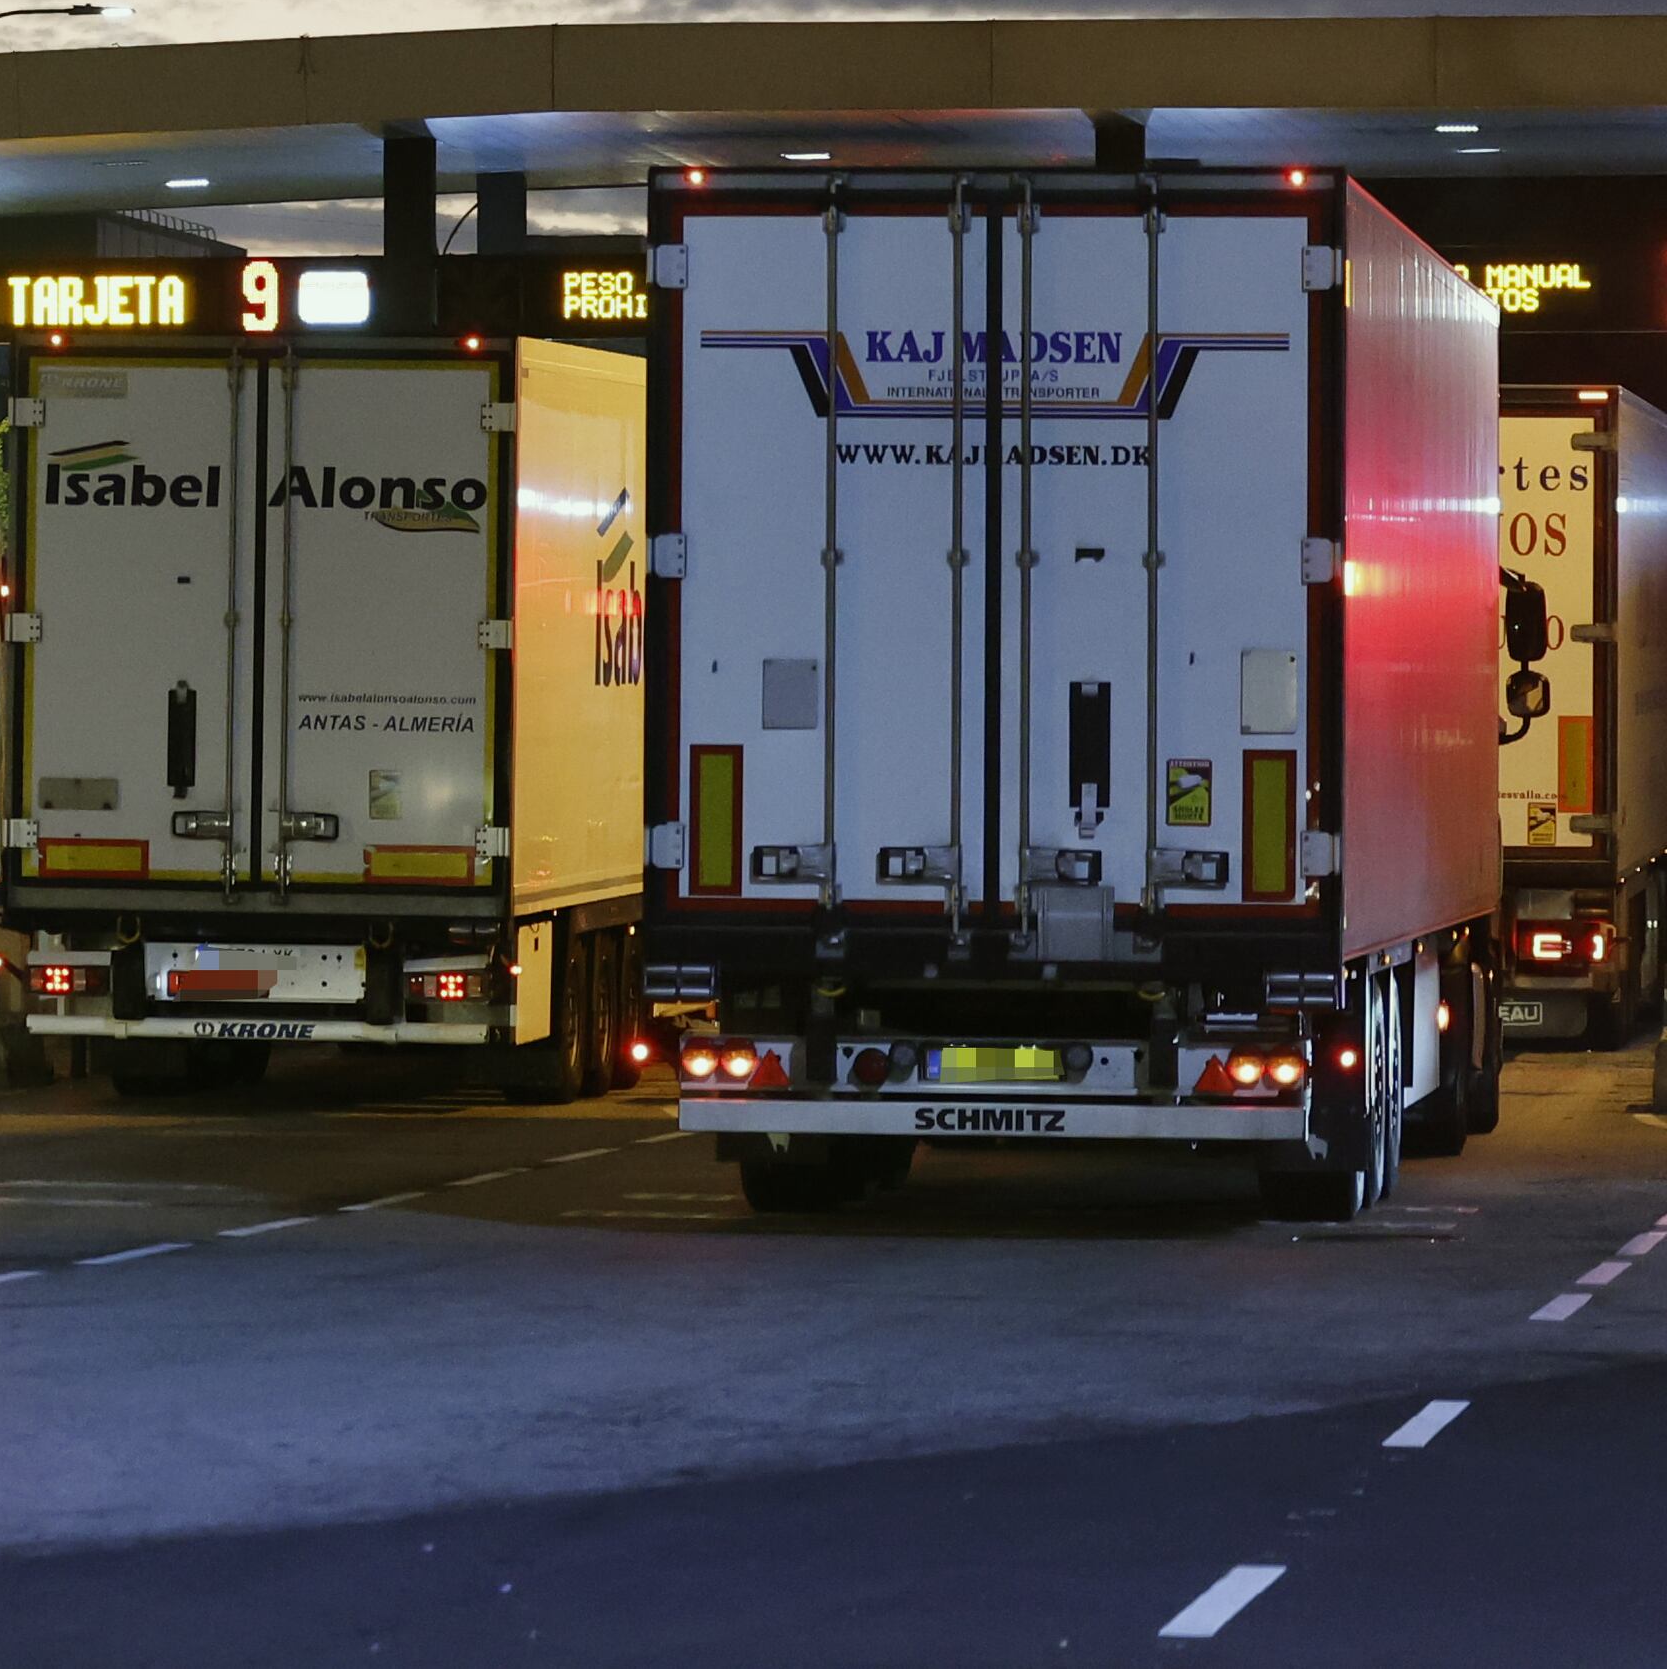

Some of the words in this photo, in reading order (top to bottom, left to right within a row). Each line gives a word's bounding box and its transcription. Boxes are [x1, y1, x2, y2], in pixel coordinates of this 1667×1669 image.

[563, 271, 634, 295] PESO
[1485, 263, 1592, 289] MANUAL
[7, 275, 186, 327] TARJETA
[242, 260, 280, 332] 9
[563, 294, 648, 320] PROHI
[1480, 287, 1540, 312] TOS
[865, 330, 945, 363] KAJ
[1004, 387, 1100, 399] TRNSPORTER
[835, 444, 1150, 466] WWW.KAJADSEN.DK
[45, 463, 221, 507] Isabel
[269, 466, 488, 512] Alonso
[1499, 512, 1567, 557] OS
[298, 714, 367, 731] ANTAS
[383, 712, 475, 733] ALMERÍA
[217, 1022, 316, 1040] KRONE
[914, 1107, 1066, 1133] SCHMITZ
